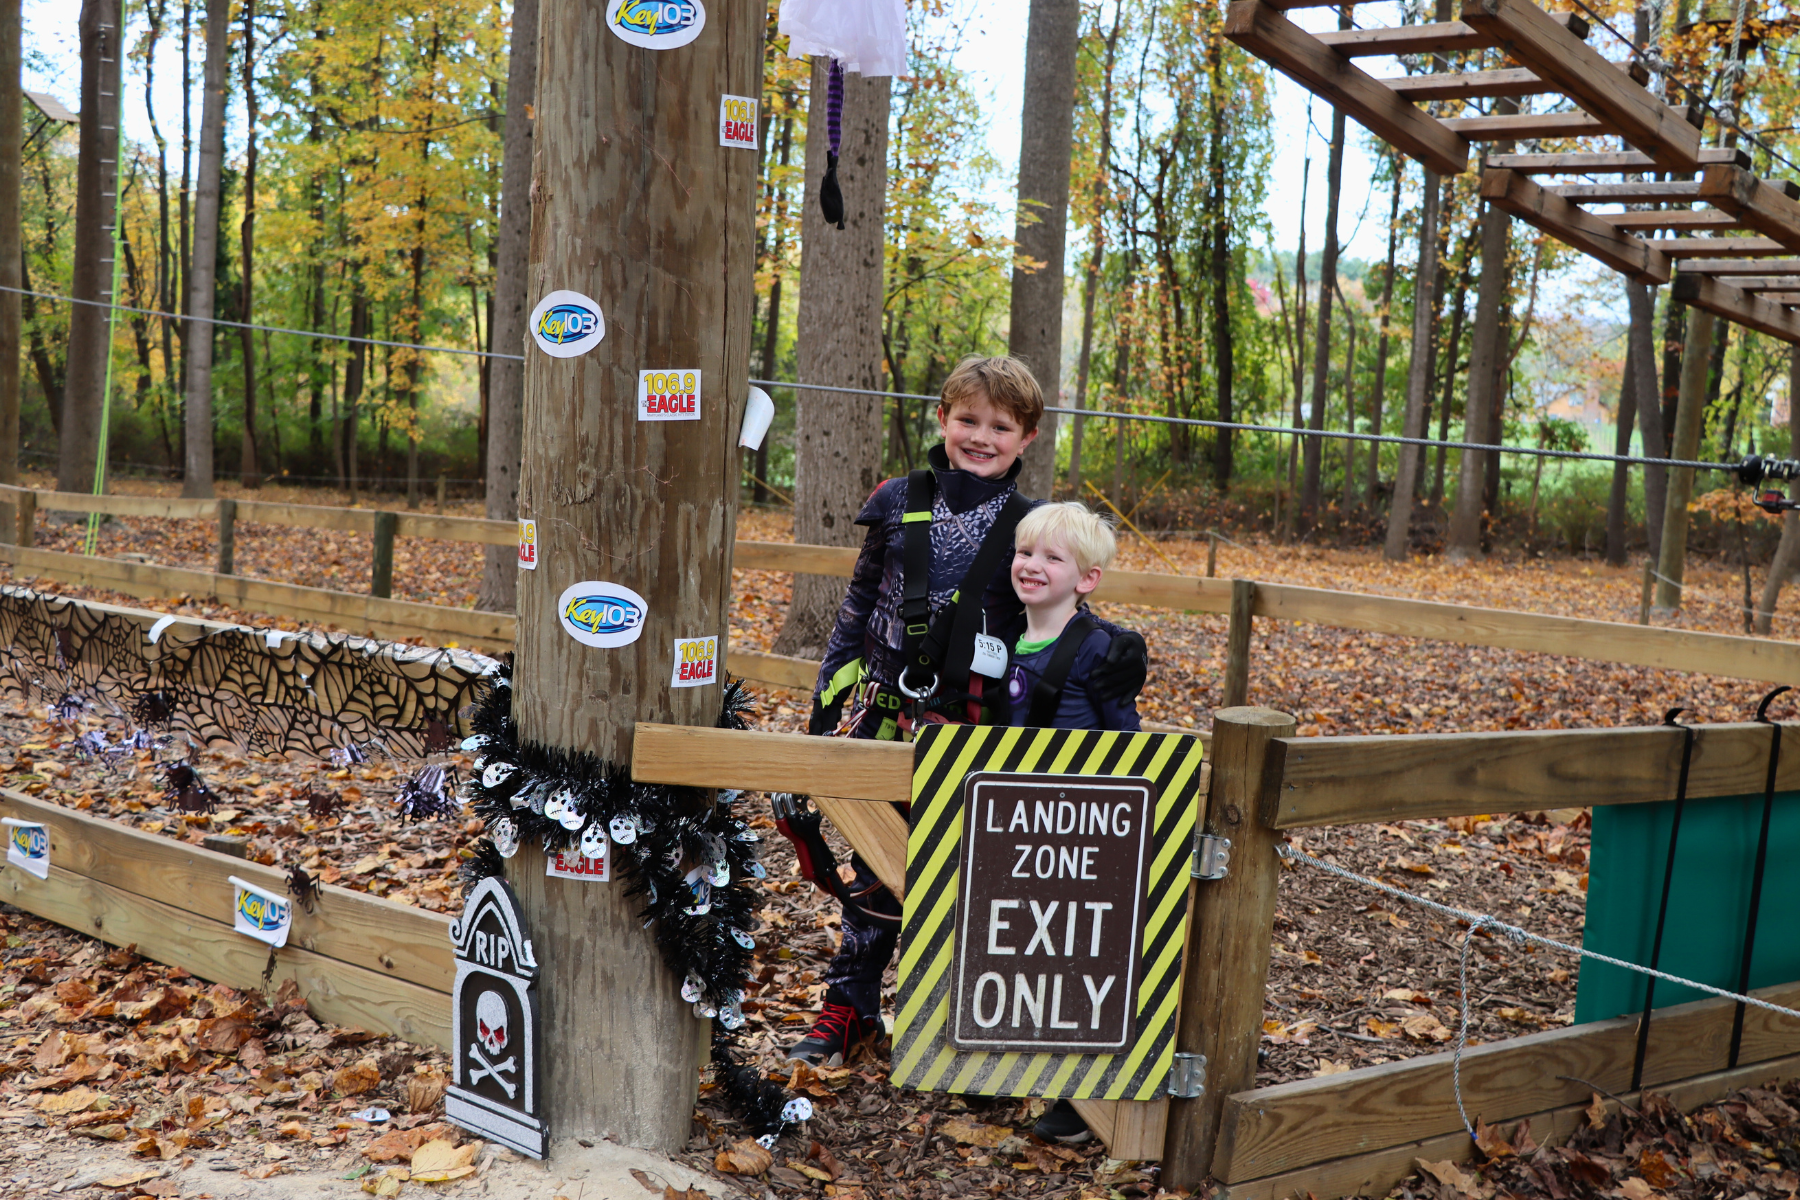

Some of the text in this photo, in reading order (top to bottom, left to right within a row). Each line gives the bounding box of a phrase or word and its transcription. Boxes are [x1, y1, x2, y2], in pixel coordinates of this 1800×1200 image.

[724, 99, 755, 123] 106.9
[725, 121, 754, 142] EAGLE
[644, 372, 696, 395] 106.9
[647, 394, 696, 413] EAGLE
[679, 639, 715, 662] 106.9
[978, 638, 995, 652] 5:15
[996, 644, 1002, 654] P
[679, 660, 713, 680] EAGLE
[986, 798, 1132, 837] LANDING
[1011, 844, 1099, 879] ZONE
[987, 899, 1113, 957] EXIT
[475, 930, 510, 969] RIP
[972, 971, 1116, 1030] ONLY
